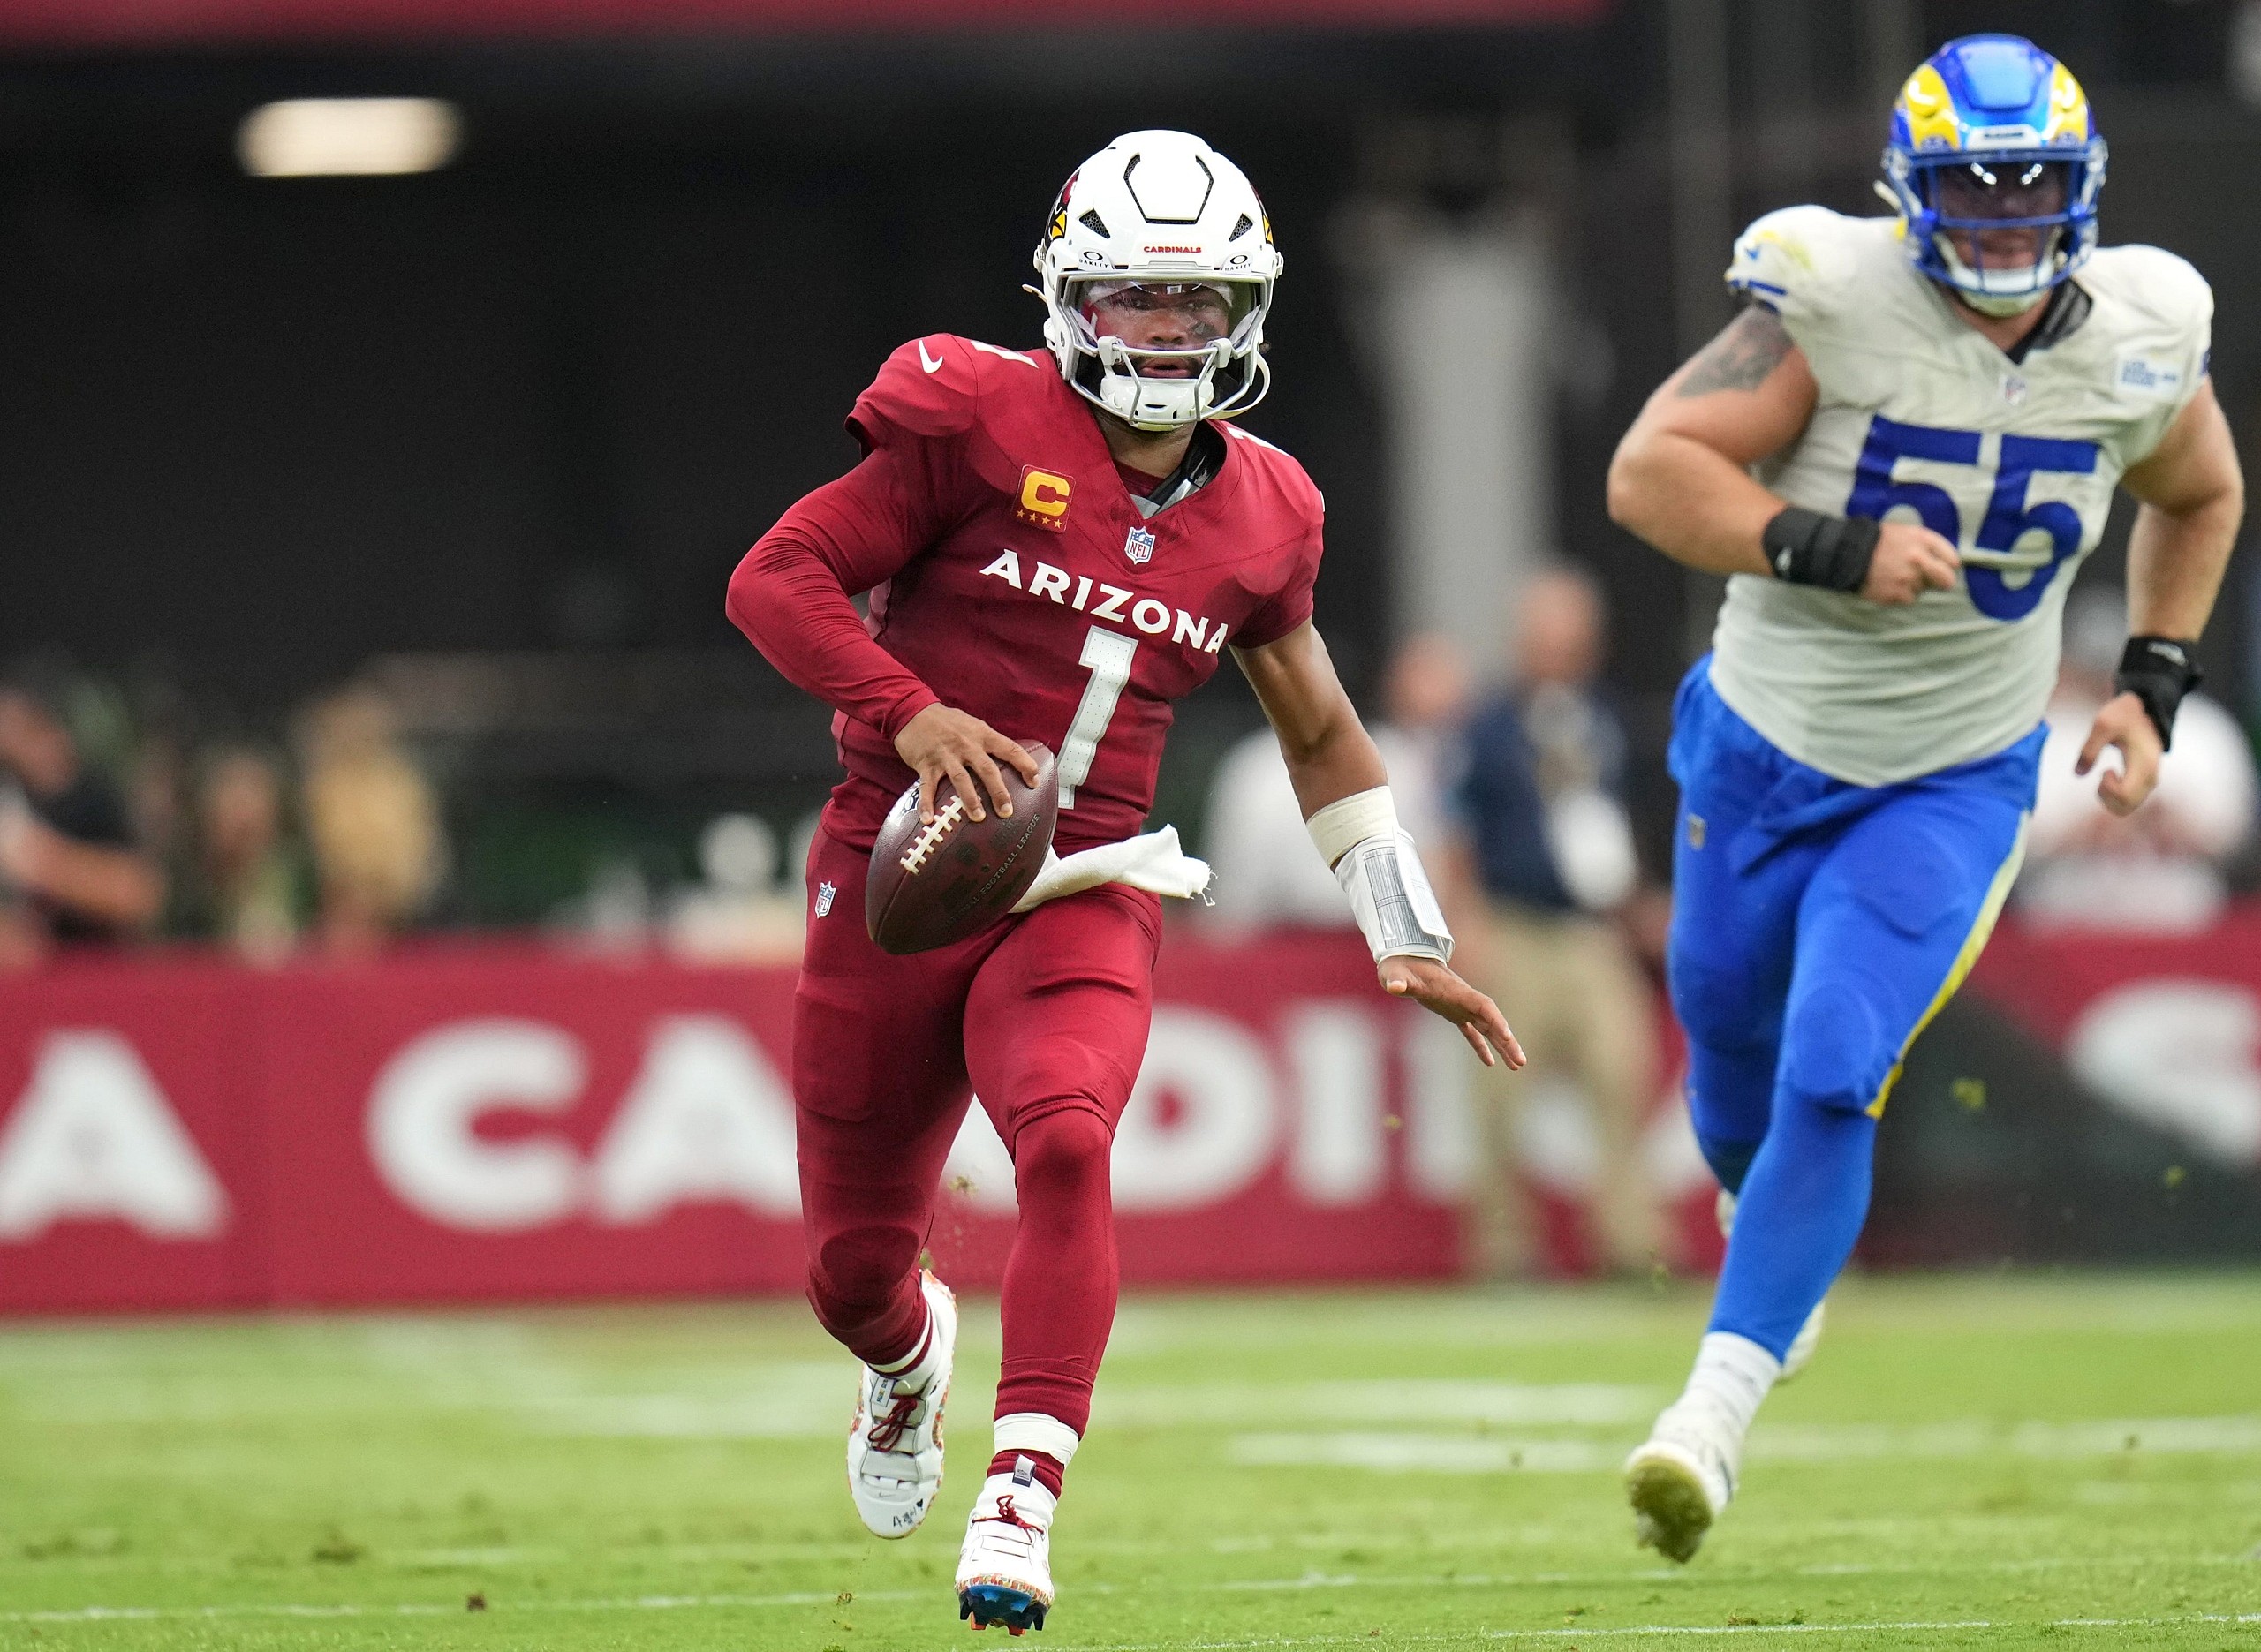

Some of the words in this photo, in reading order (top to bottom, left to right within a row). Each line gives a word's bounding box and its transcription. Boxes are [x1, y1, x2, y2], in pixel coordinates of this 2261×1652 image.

[1078, 259, 1108, 268] OAKLEY
[1144, 245, 1202, 254] CARDINALS
[1021, 471, 1070, 517] C
[1845, 413, 2101, 624] 55
[1130, 540, 1147, 558] NFL
[979, 548, 1229, 654] ARIZONA
[1057, 624, 1139, 810] 1
[980, 852, 1018, 895] FOOTBALL
[1017, 813, 1040, 849] LEAGUE
